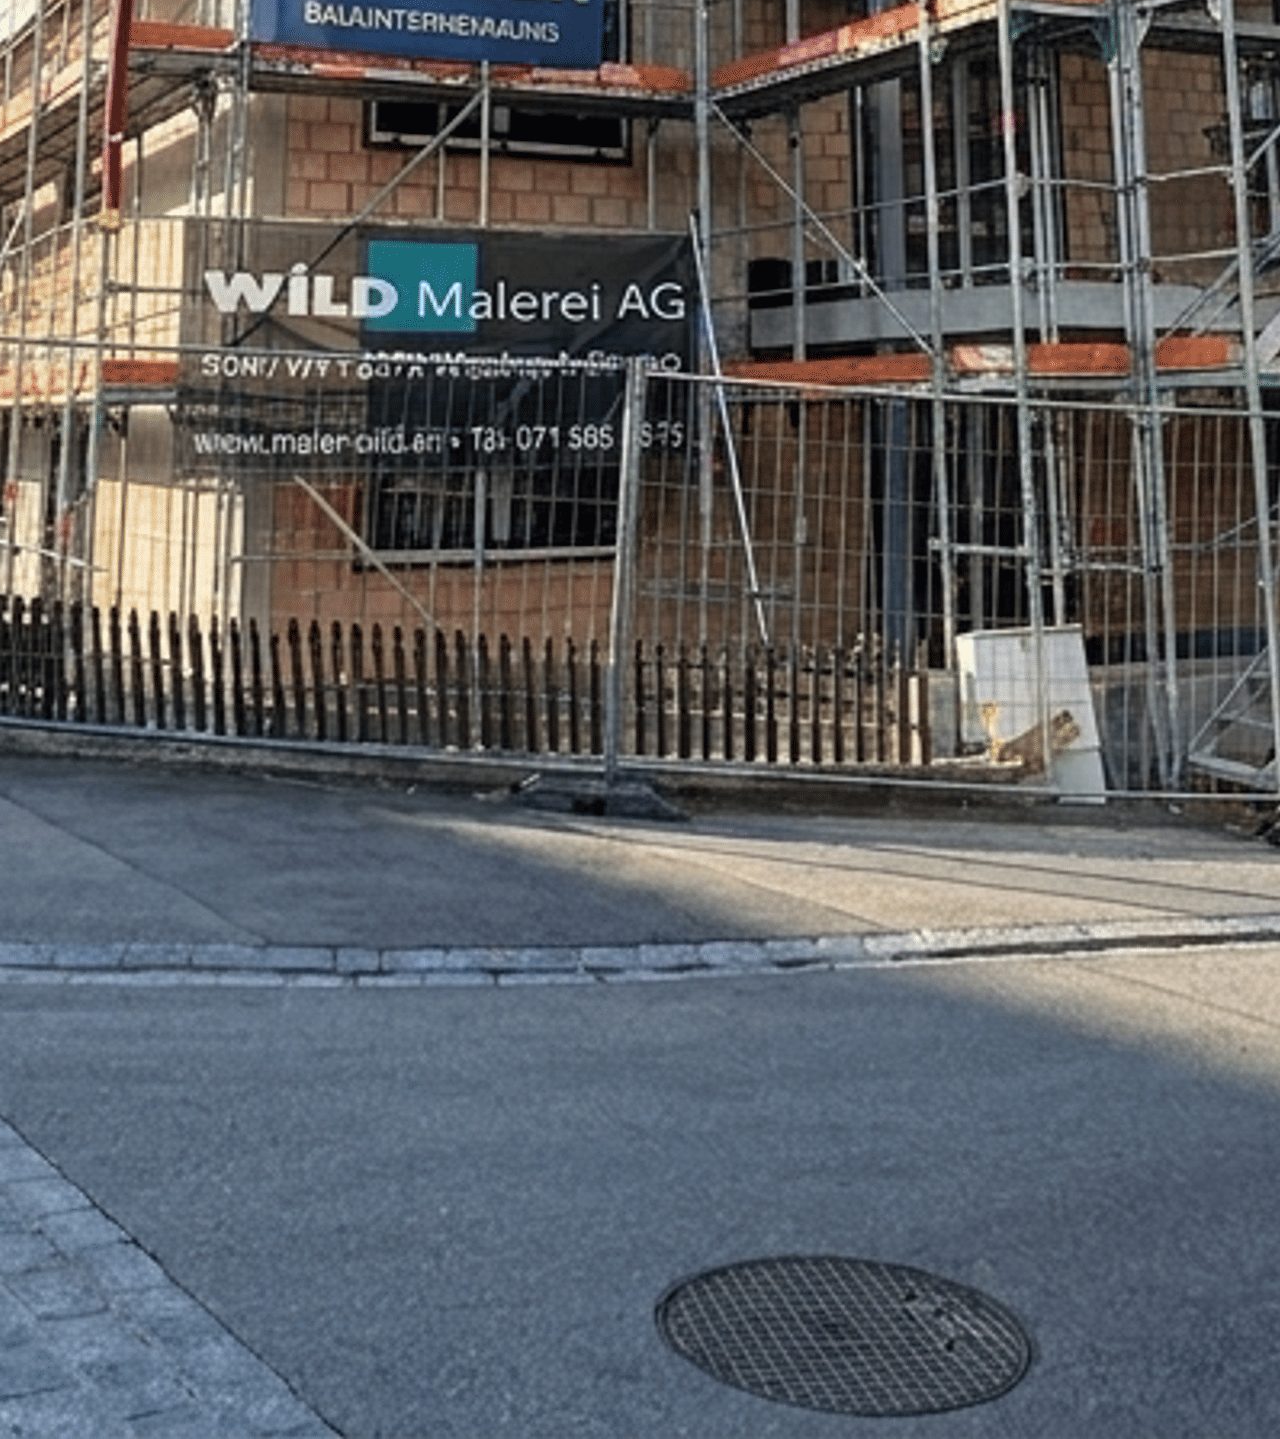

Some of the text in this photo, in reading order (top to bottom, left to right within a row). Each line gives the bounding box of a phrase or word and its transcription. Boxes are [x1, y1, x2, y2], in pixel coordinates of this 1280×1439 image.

[417, 279, 600, 321] Malerei
[618, 282, 687, 320] AG
[515, 424, 560, 451] 071
